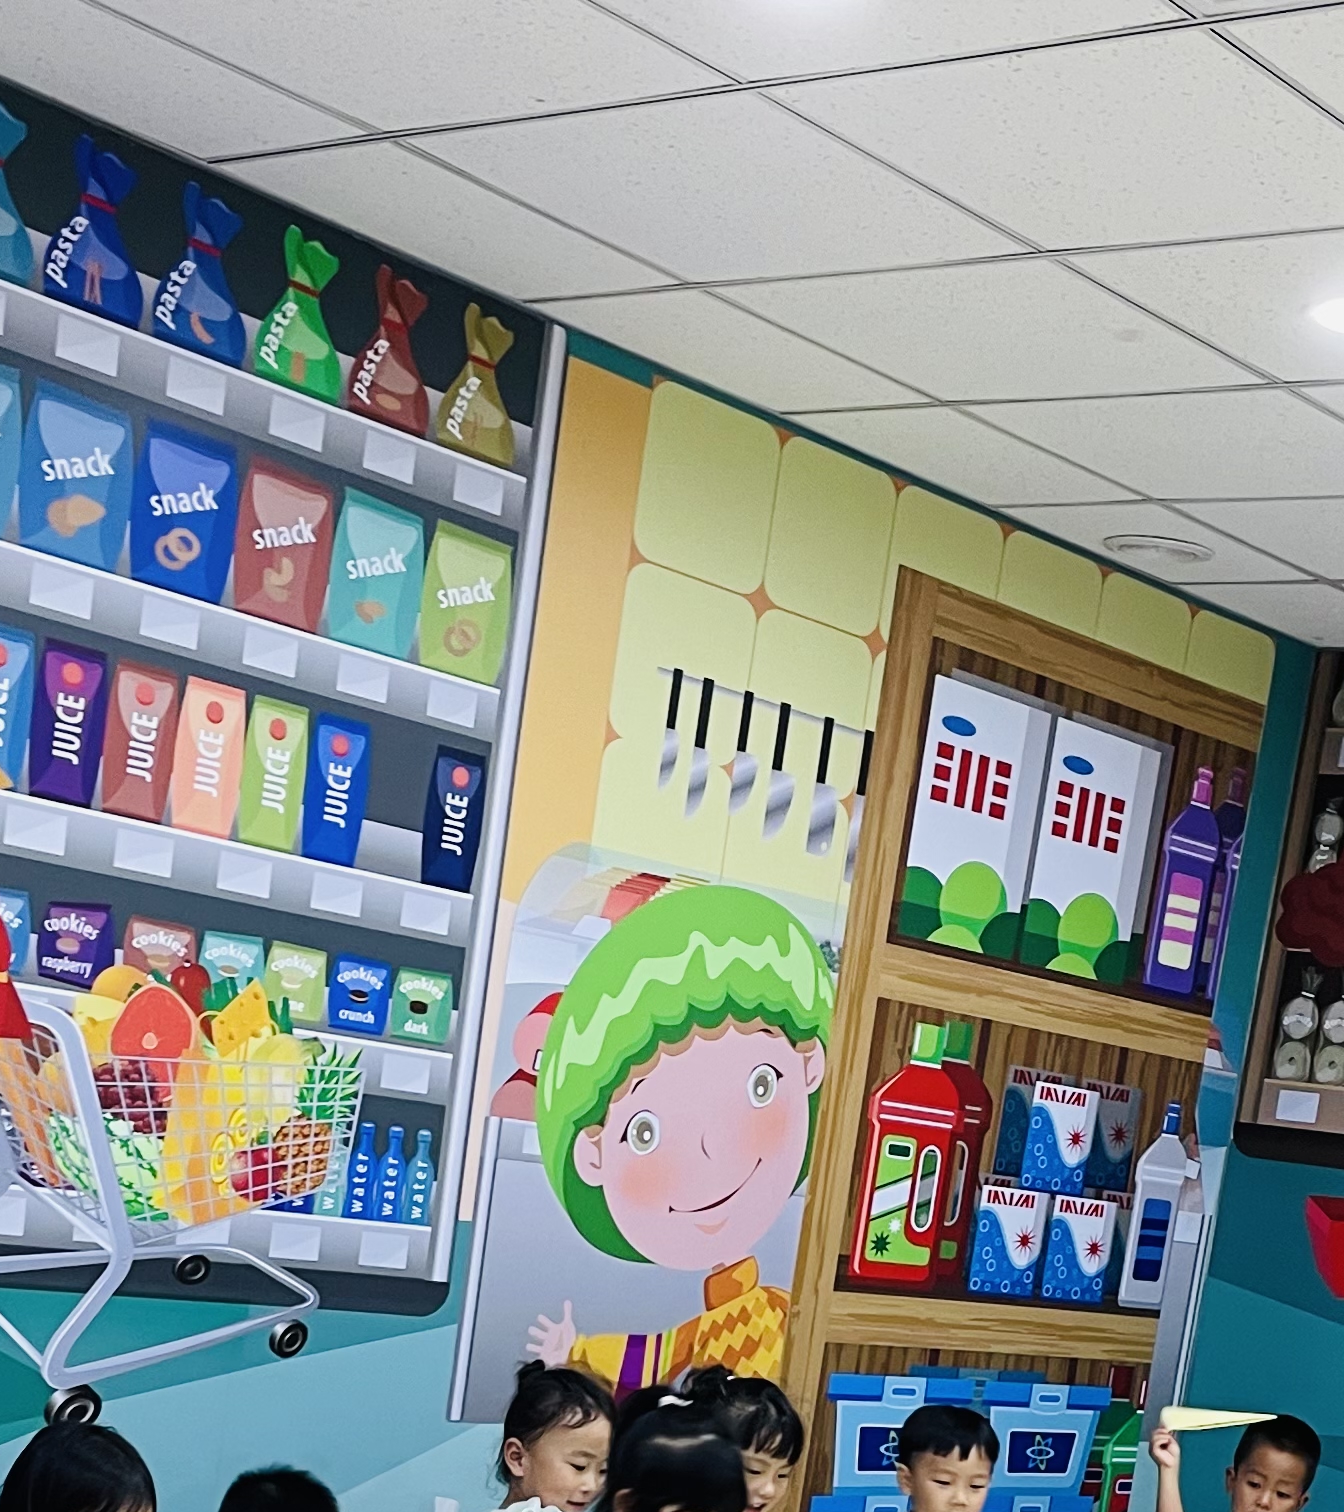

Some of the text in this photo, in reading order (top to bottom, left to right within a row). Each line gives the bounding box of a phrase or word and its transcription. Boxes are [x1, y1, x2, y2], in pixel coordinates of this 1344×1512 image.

[45, 215, 90, 289] pasta
[155, 260, 197, 331] pasta
[259, 301, 299, 369] pasta
[353, 338, 390, 405] pasta
[446, 376, 483, 440] pasta
[41, 447, 115, 481] snack
[150, 482, 219, 516] snack
[252, 517, 317, 550] snack
[346, 547, 407, 579] snack
[437, 577, 495, 609] snack
[52, 692, 86, 765] JUICE
[126, 711, 159, 783] JUICE
[193, 728, 224, 798] JUICE
[261, 747, 290, 814] JUICE
[323, 761, 353, 829] JUICE
[441, 792, 469, 856] JUICE
[43, 912, 101, 940] cookies
[131, 930, 188, 958] cookies
[205, 944, 255, 968] cookies
[271, 955, 317, 980] cookies
[336, 965, 385, 990] cookies
[338, 1007, 375, 1025] crunch
[399, 977, 445, 1000] cookies
[403, 1019, 429, 1035] dark
[351, 1152, 369, 1213] water
[382, 1156, 399, 1216] water
[411, 1160, 428, 1219] water
